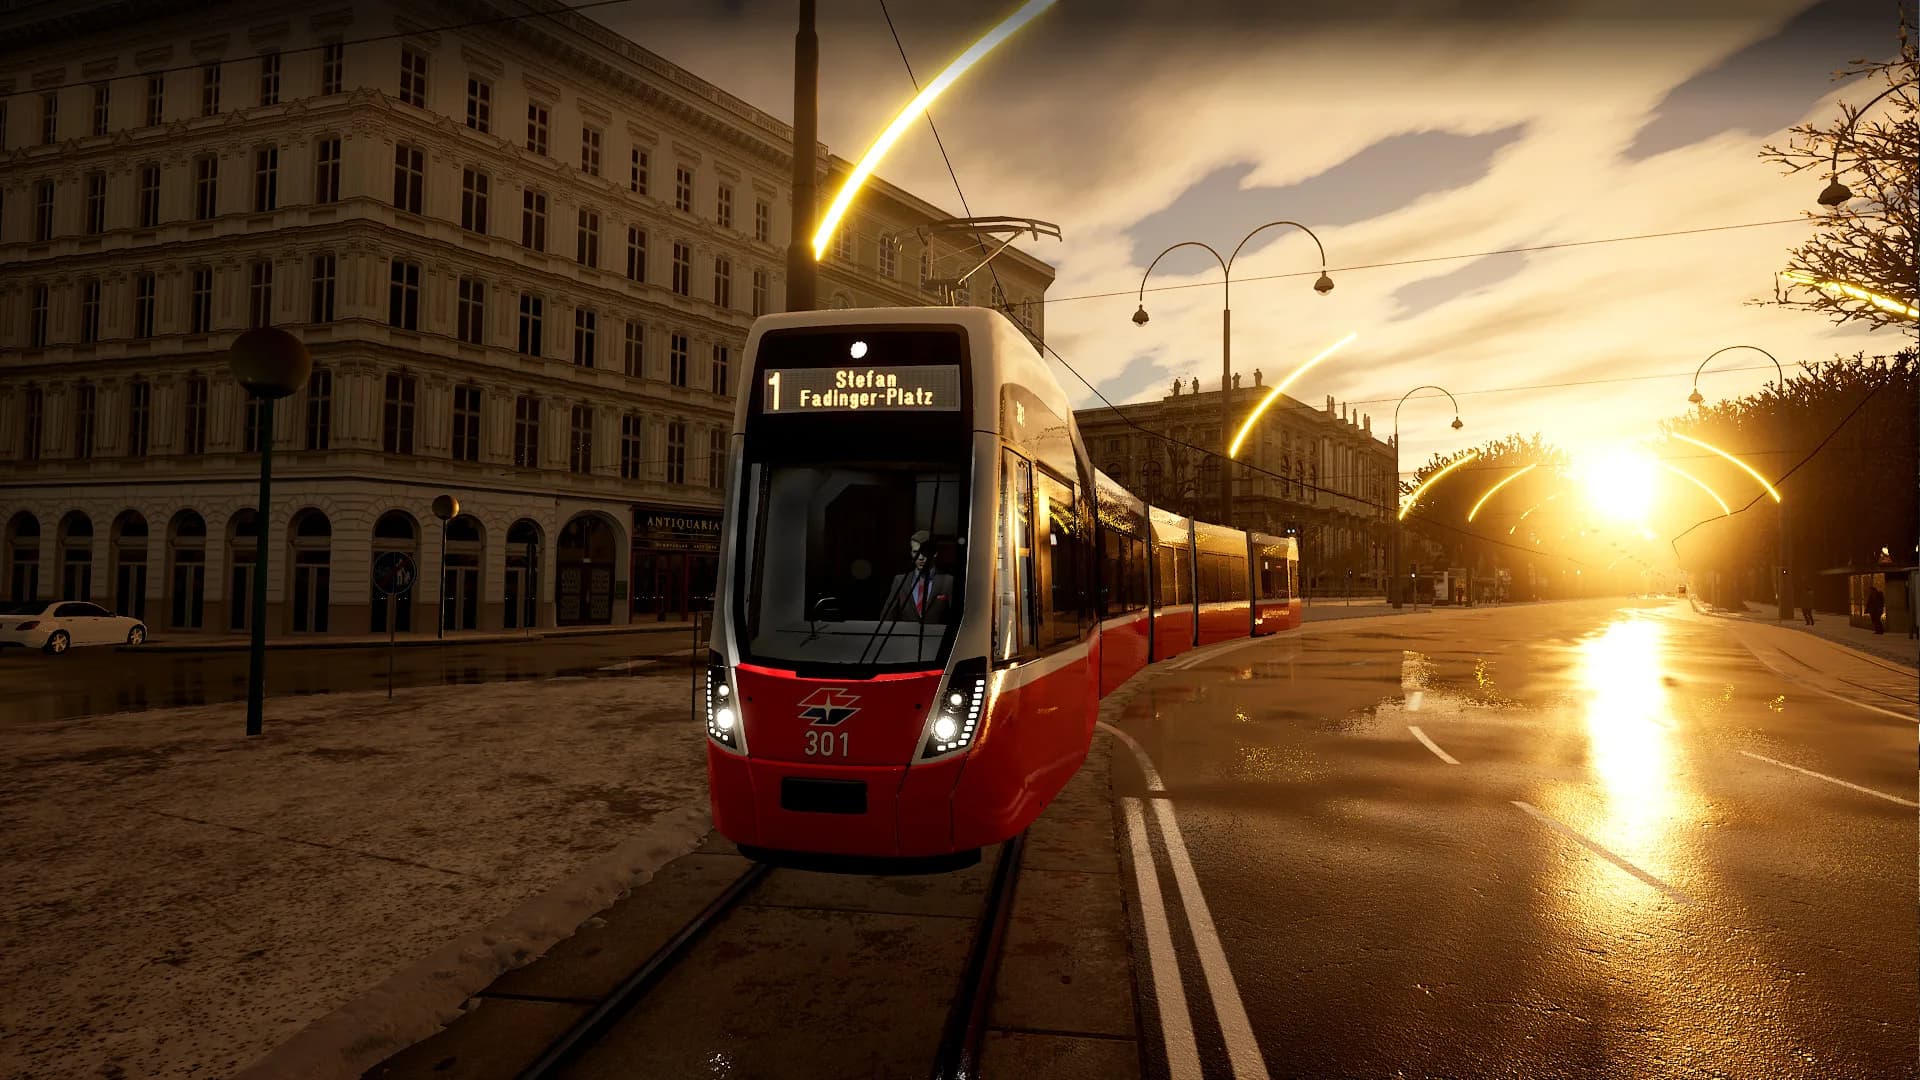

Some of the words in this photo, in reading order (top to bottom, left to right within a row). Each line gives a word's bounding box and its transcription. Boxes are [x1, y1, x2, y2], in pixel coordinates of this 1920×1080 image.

[835, 370, 897, 389] Stefan
[768, 371, 781, 411] 1
[799, 389, 933, 410] Fadinger-Platz
[647, 515, 722, 531] ANTIQUARIA
[804, 731, 849, 757] 301
